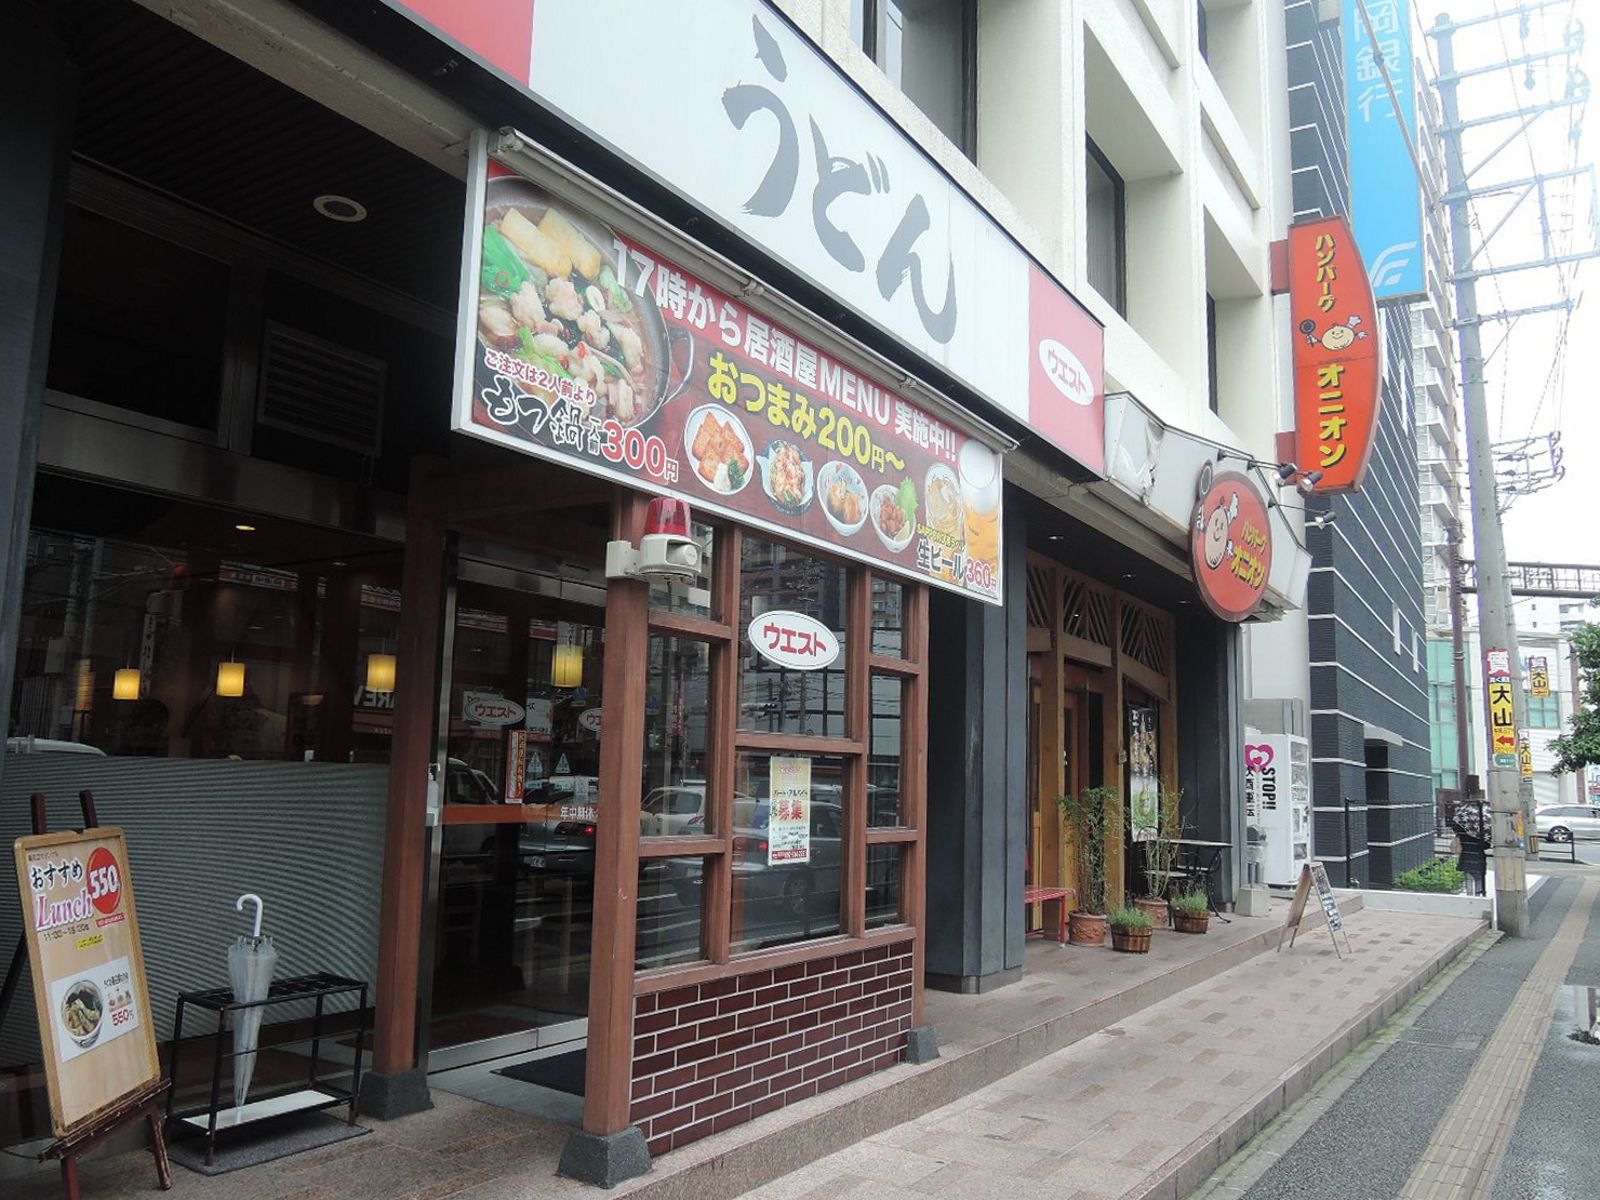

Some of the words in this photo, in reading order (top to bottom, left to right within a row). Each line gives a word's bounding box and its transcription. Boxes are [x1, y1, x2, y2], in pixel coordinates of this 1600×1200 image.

[721, 14, 957, 344] うどん
[1315, 233, 1336, 313] ハンバーグ
[485, 349, 596, 406] ご注文は2人前より
[1047, 346, 1087, 396] ウエスト
[1317, 364, 1346, 468] オニオン
[602, 419, 679, 482] 300円
[917, 538, 967, 582] 生ビール
[763, 622, 827, 658] ウエスト
[474, 703, 517, 719] ウエスト
[1492, 686, 1512, 727] 大山
[1262, 767, 1277, 811] STOP!!
[31, 859, 84, 890] おすすめ
[36, 888, 93, 931] Lunch
